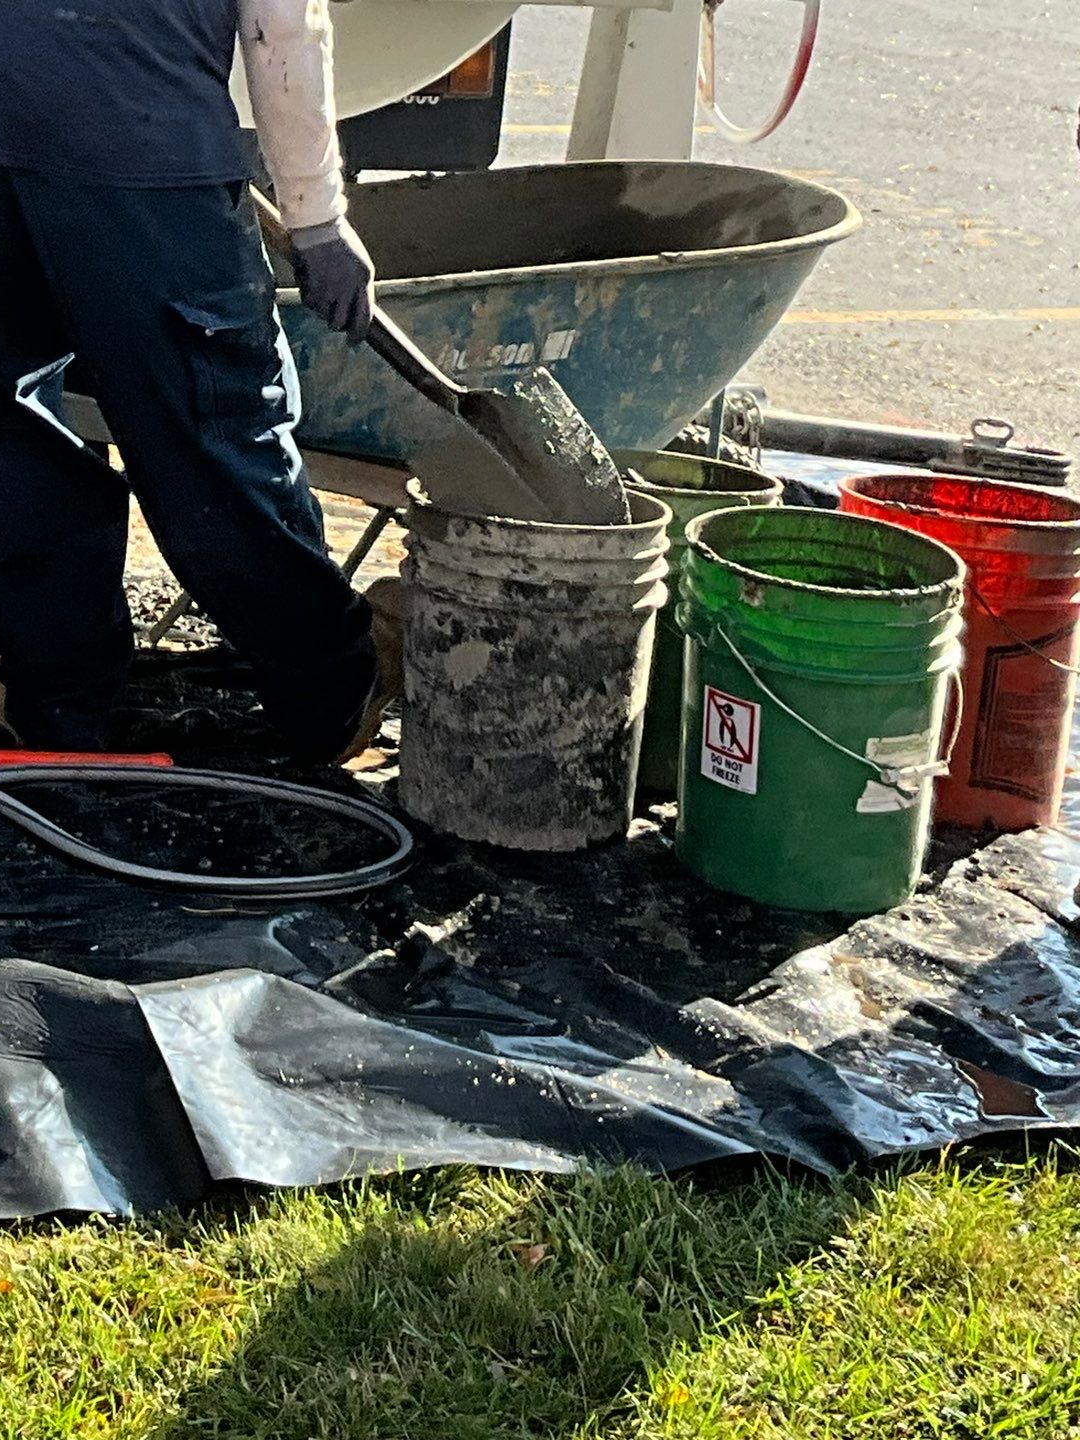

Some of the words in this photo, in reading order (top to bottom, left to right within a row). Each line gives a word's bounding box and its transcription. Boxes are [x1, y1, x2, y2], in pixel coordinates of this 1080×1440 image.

[710, 752, 723, 766] DO
[724, 758, 744, 773] NOT
[711, 765, 742, 785] FREEZE
